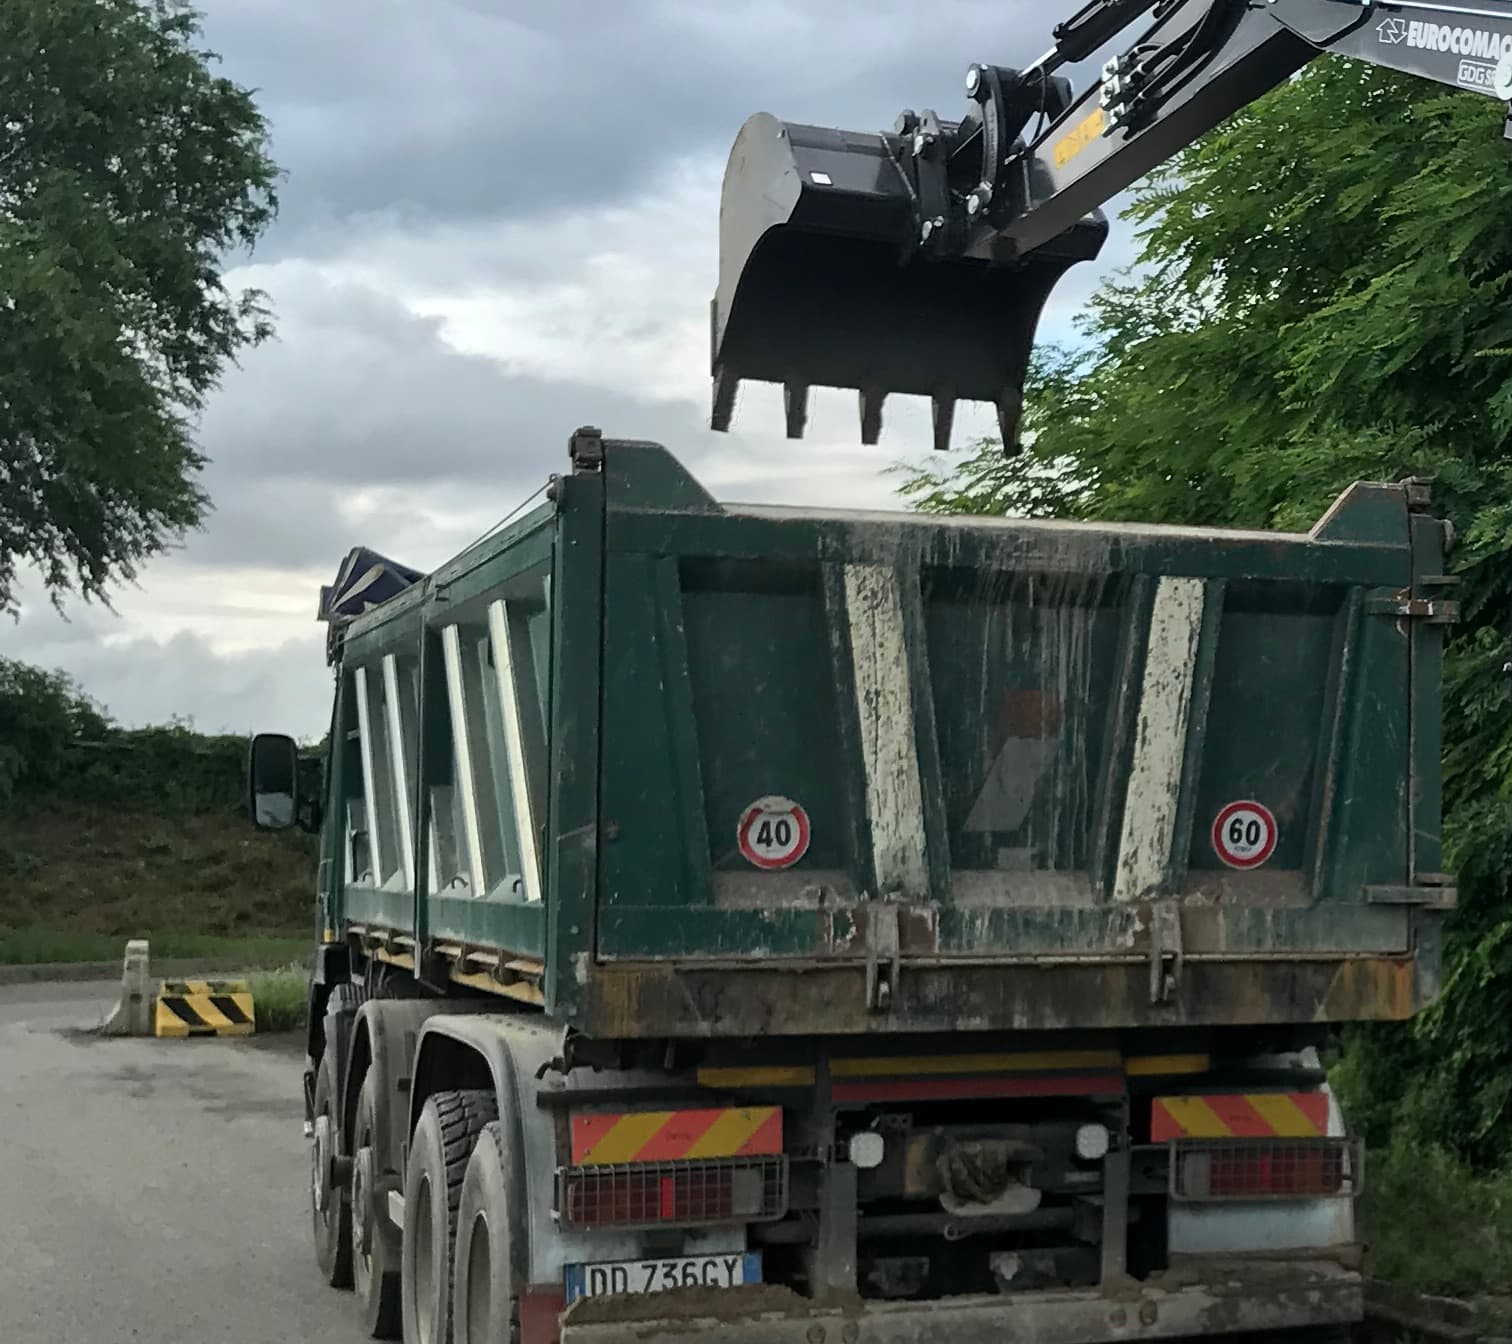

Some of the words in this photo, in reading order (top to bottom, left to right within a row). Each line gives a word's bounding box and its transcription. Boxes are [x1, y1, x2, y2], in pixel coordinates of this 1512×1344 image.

[1459, 64, 1485, 84] GDG
[756, 819, 792, 848] 40
[1229, 817, 1261, 846] 60
[591, 1267, 629, 1297] DD
